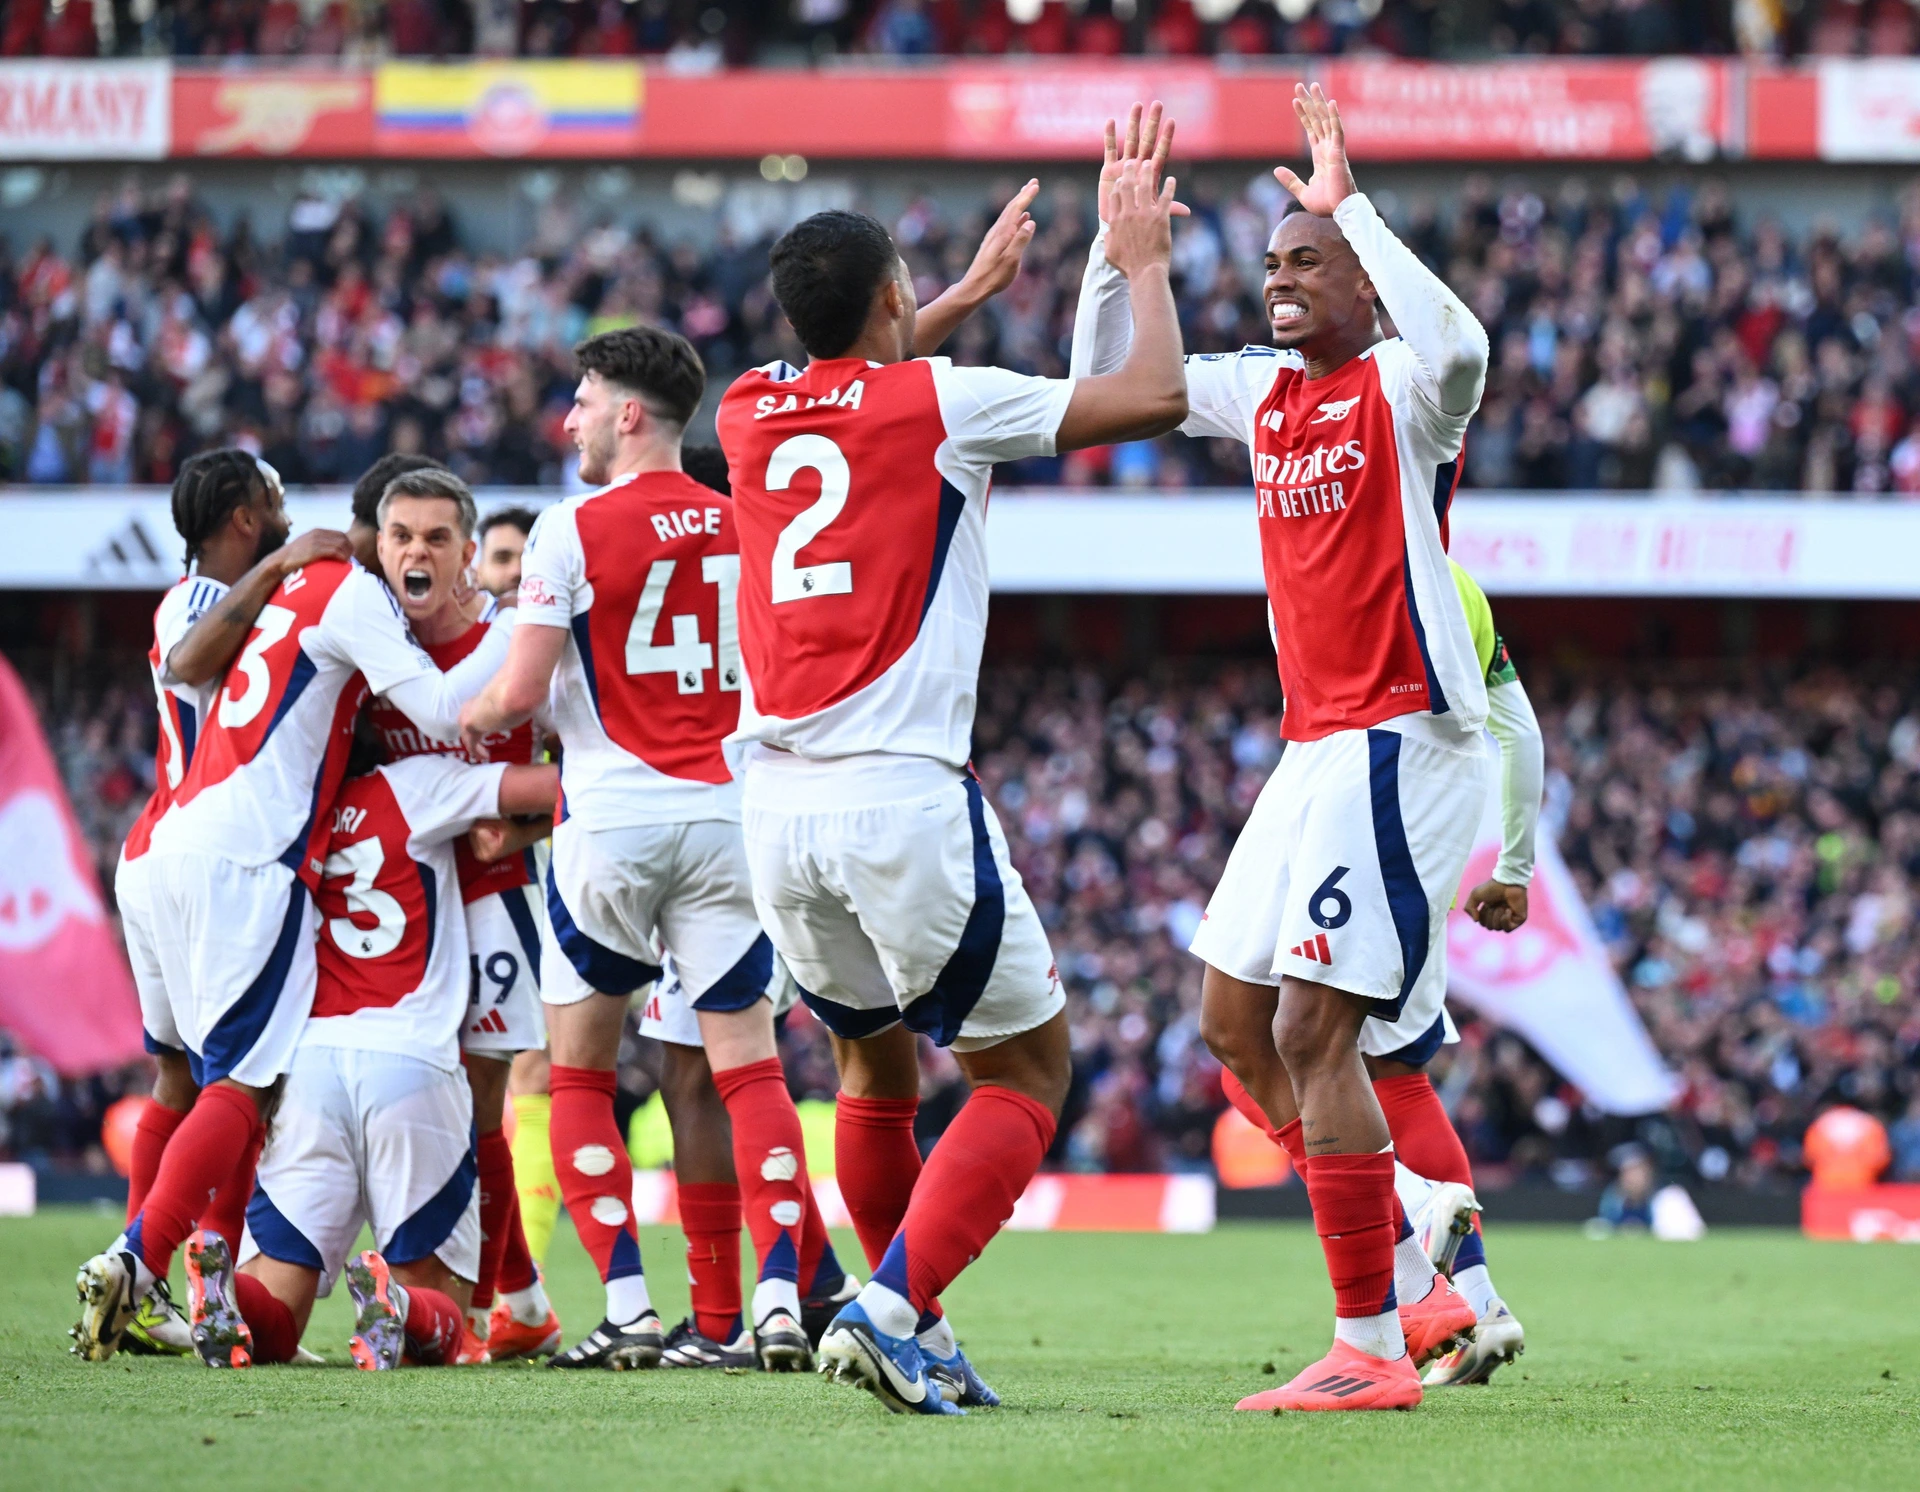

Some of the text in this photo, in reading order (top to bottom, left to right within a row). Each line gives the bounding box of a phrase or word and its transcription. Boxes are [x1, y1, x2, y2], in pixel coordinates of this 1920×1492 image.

[1256, 439, 1366, 485] mirates
[765, 433, 852, 604] 2
[1277, 481, 1347, 518] BETTER
[650, 507, 721, 542] RICE
[625, 554, 741, 695] 41
[1390, 683, 1423, 694] HEAT.RDY
[1308, 865, 1352, 930] 6
[470, 951, 519, 1004] 19
